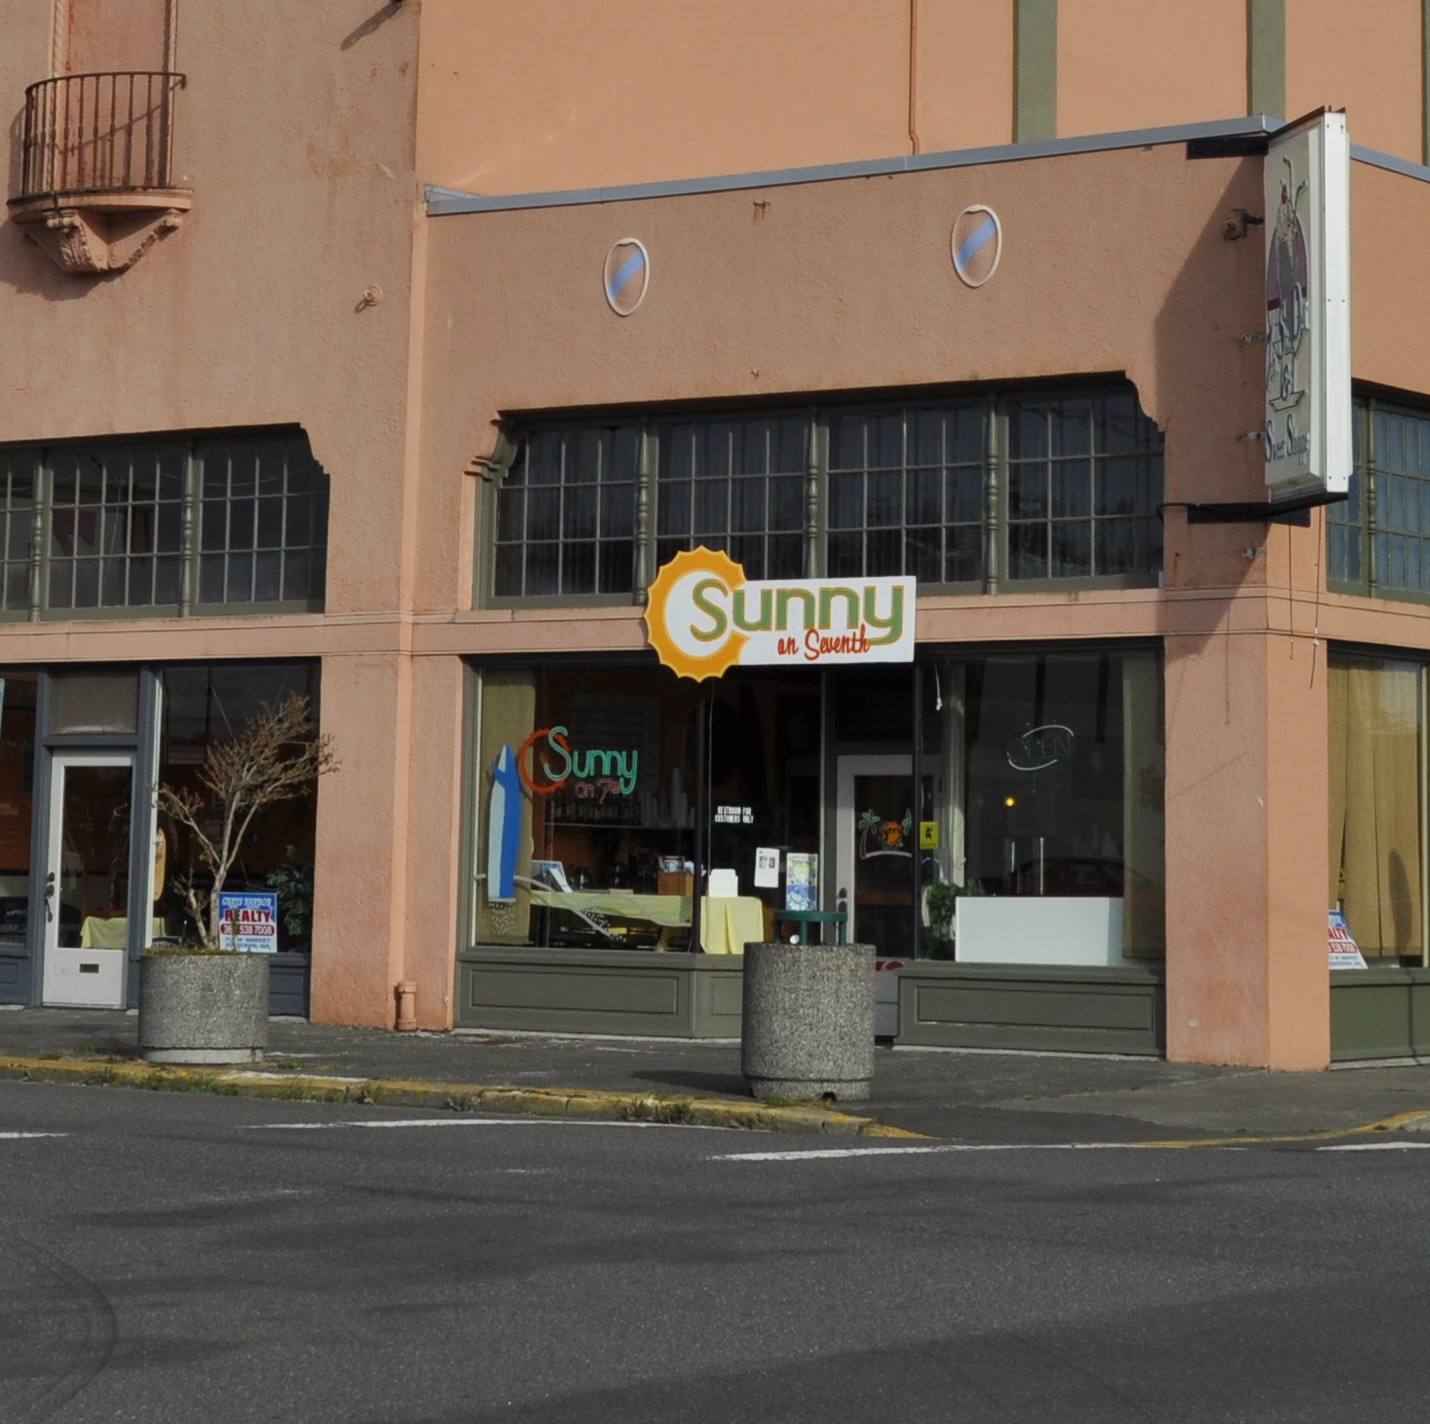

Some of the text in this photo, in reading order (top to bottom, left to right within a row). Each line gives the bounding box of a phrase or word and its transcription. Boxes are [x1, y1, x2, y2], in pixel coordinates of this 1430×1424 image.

[689, 578, 905, 646] Sunny
[777, 623, 870, 661] on Seventh
[543, 726, 638, 794] Sunny
[574, 780, 595, 799] on
